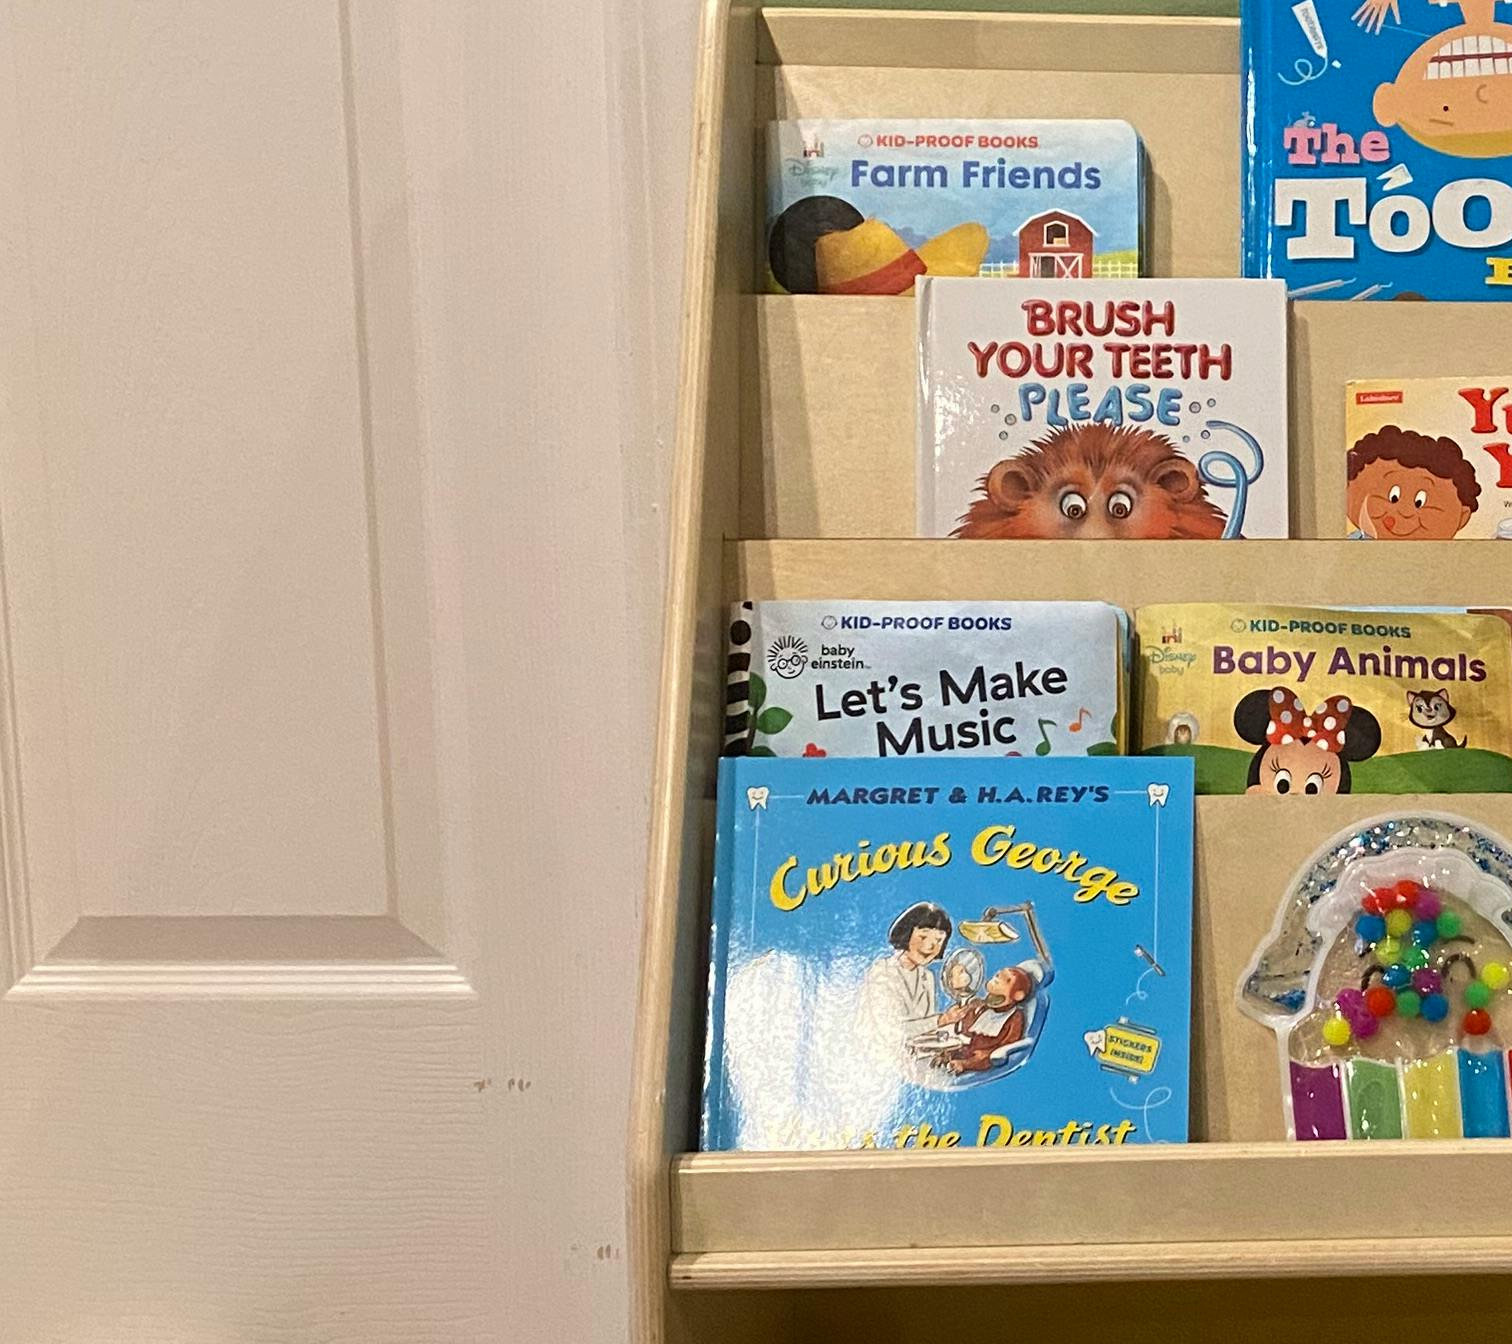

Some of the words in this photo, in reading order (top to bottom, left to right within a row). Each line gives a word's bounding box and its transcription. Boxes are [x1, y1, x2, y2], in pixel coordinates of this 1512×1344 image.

[876, 134, 975, 148] KID-PROOF
[978, 135, 1040, 149] BOOKS
[1283, 123, 1392, 166] The
[851, 159, 948, 187] Farm
[962, 158, 1101, 190] Friends
[1021, 298, 1176, 337] BRUSH
[967, 340, 1094, 379] YOUR
[1103, 342, 1233, 382] TEETH
[1018, 382, 1183, 427] PLEASE
[840, 615, 944, 631] KID-PROOF
[948, 616, 1012, 631] BOOKS
[1249, 618, 1349, 635] KID-PROOF
[1351, 623, 1412, 639] BOOKS
[811, 656, 865, 669] einstein
[821, 643, 855, 658] baby
[1212, 645, 1317, 683] Baby
[1327, 645, 1487, 682] Animals
[815, 674, 924, 721] Let's
[939, 659, 1068, 707] Make
[876, 708, 1018, 757] Music
[806, 785, 940, 805] MARGRET
[948, 786, 968, 804] &
[769, 830, 953, 912] Curious
[970, 823, 1140, 905] George
[895, 1122, 961, 1148] the
[976, 1113, 1137, 1147] Dentist
